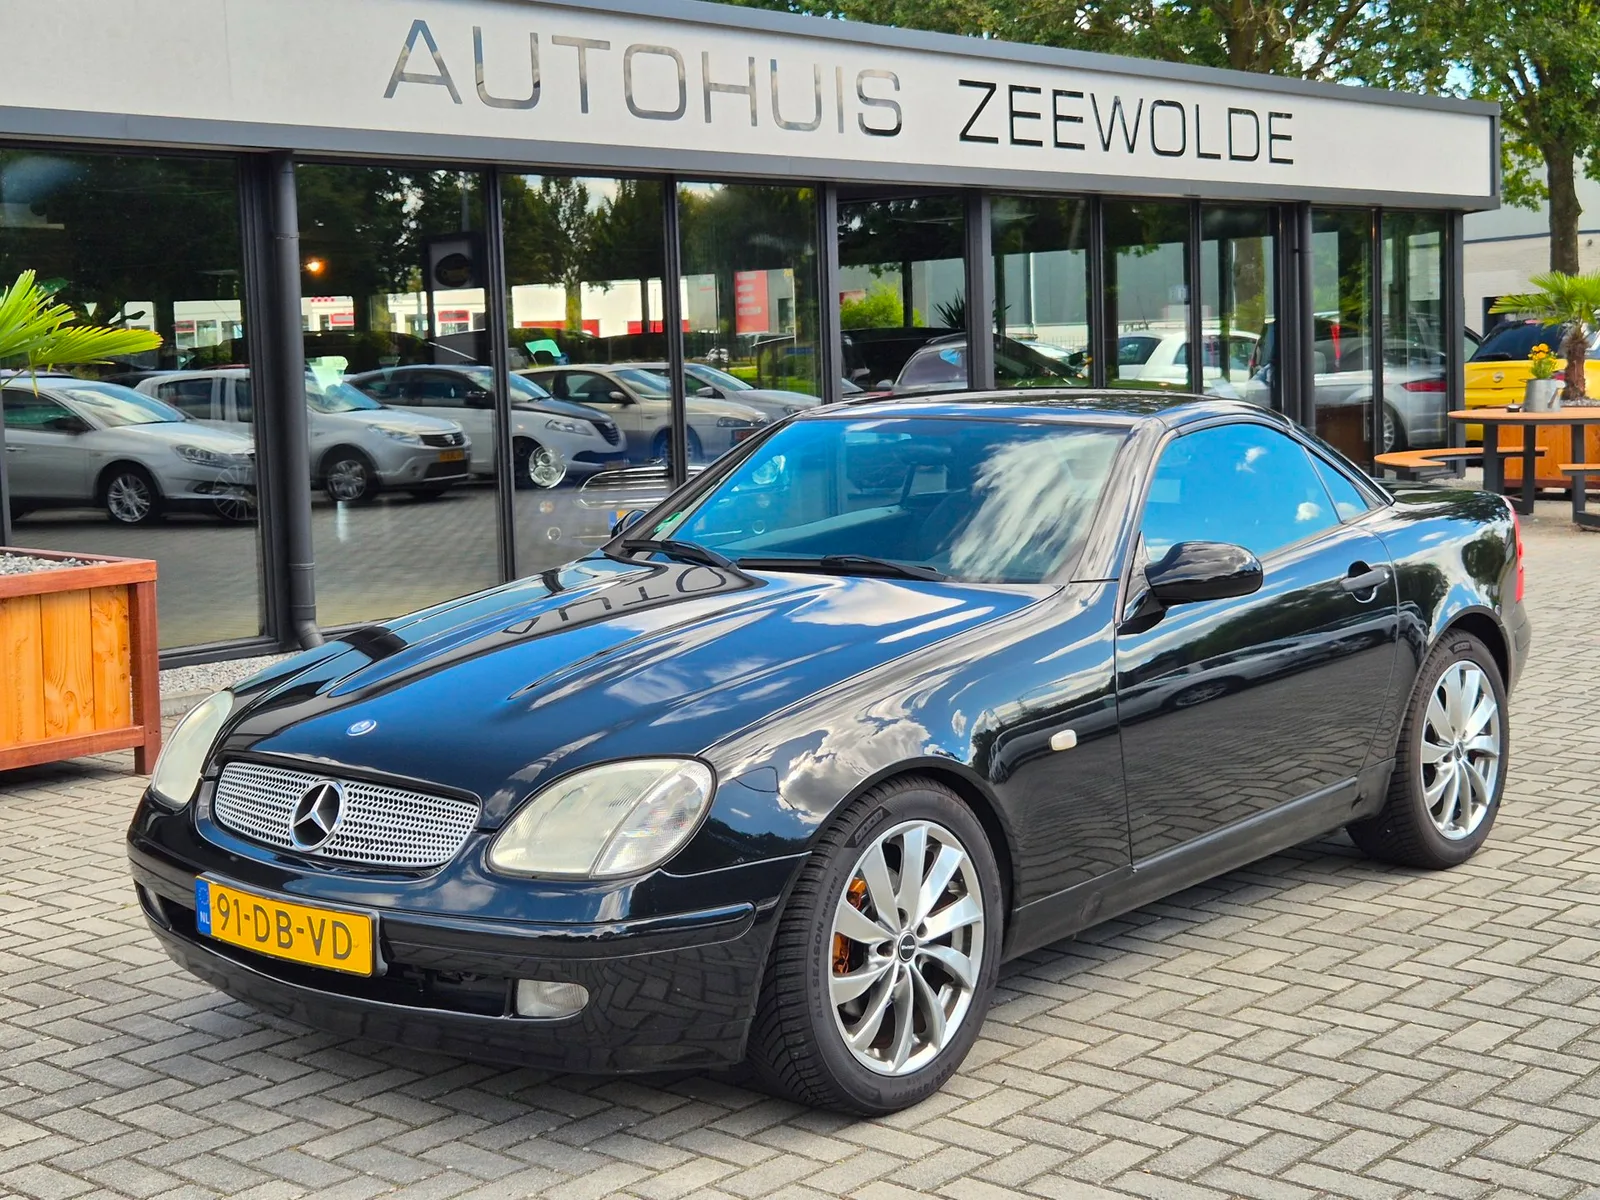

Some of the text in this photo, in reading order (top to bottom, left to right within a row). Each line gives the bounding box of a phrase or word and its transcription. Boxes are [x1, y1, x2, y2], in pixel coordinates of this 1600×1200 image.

[384, 19, 1294, 165] AUTOHUIS ZEEWOLDE
[199, 910, 210, 925] NL
[216, 892, 353, 961] 91-DB-VD
[812, 921, 825, 988] SEASON
